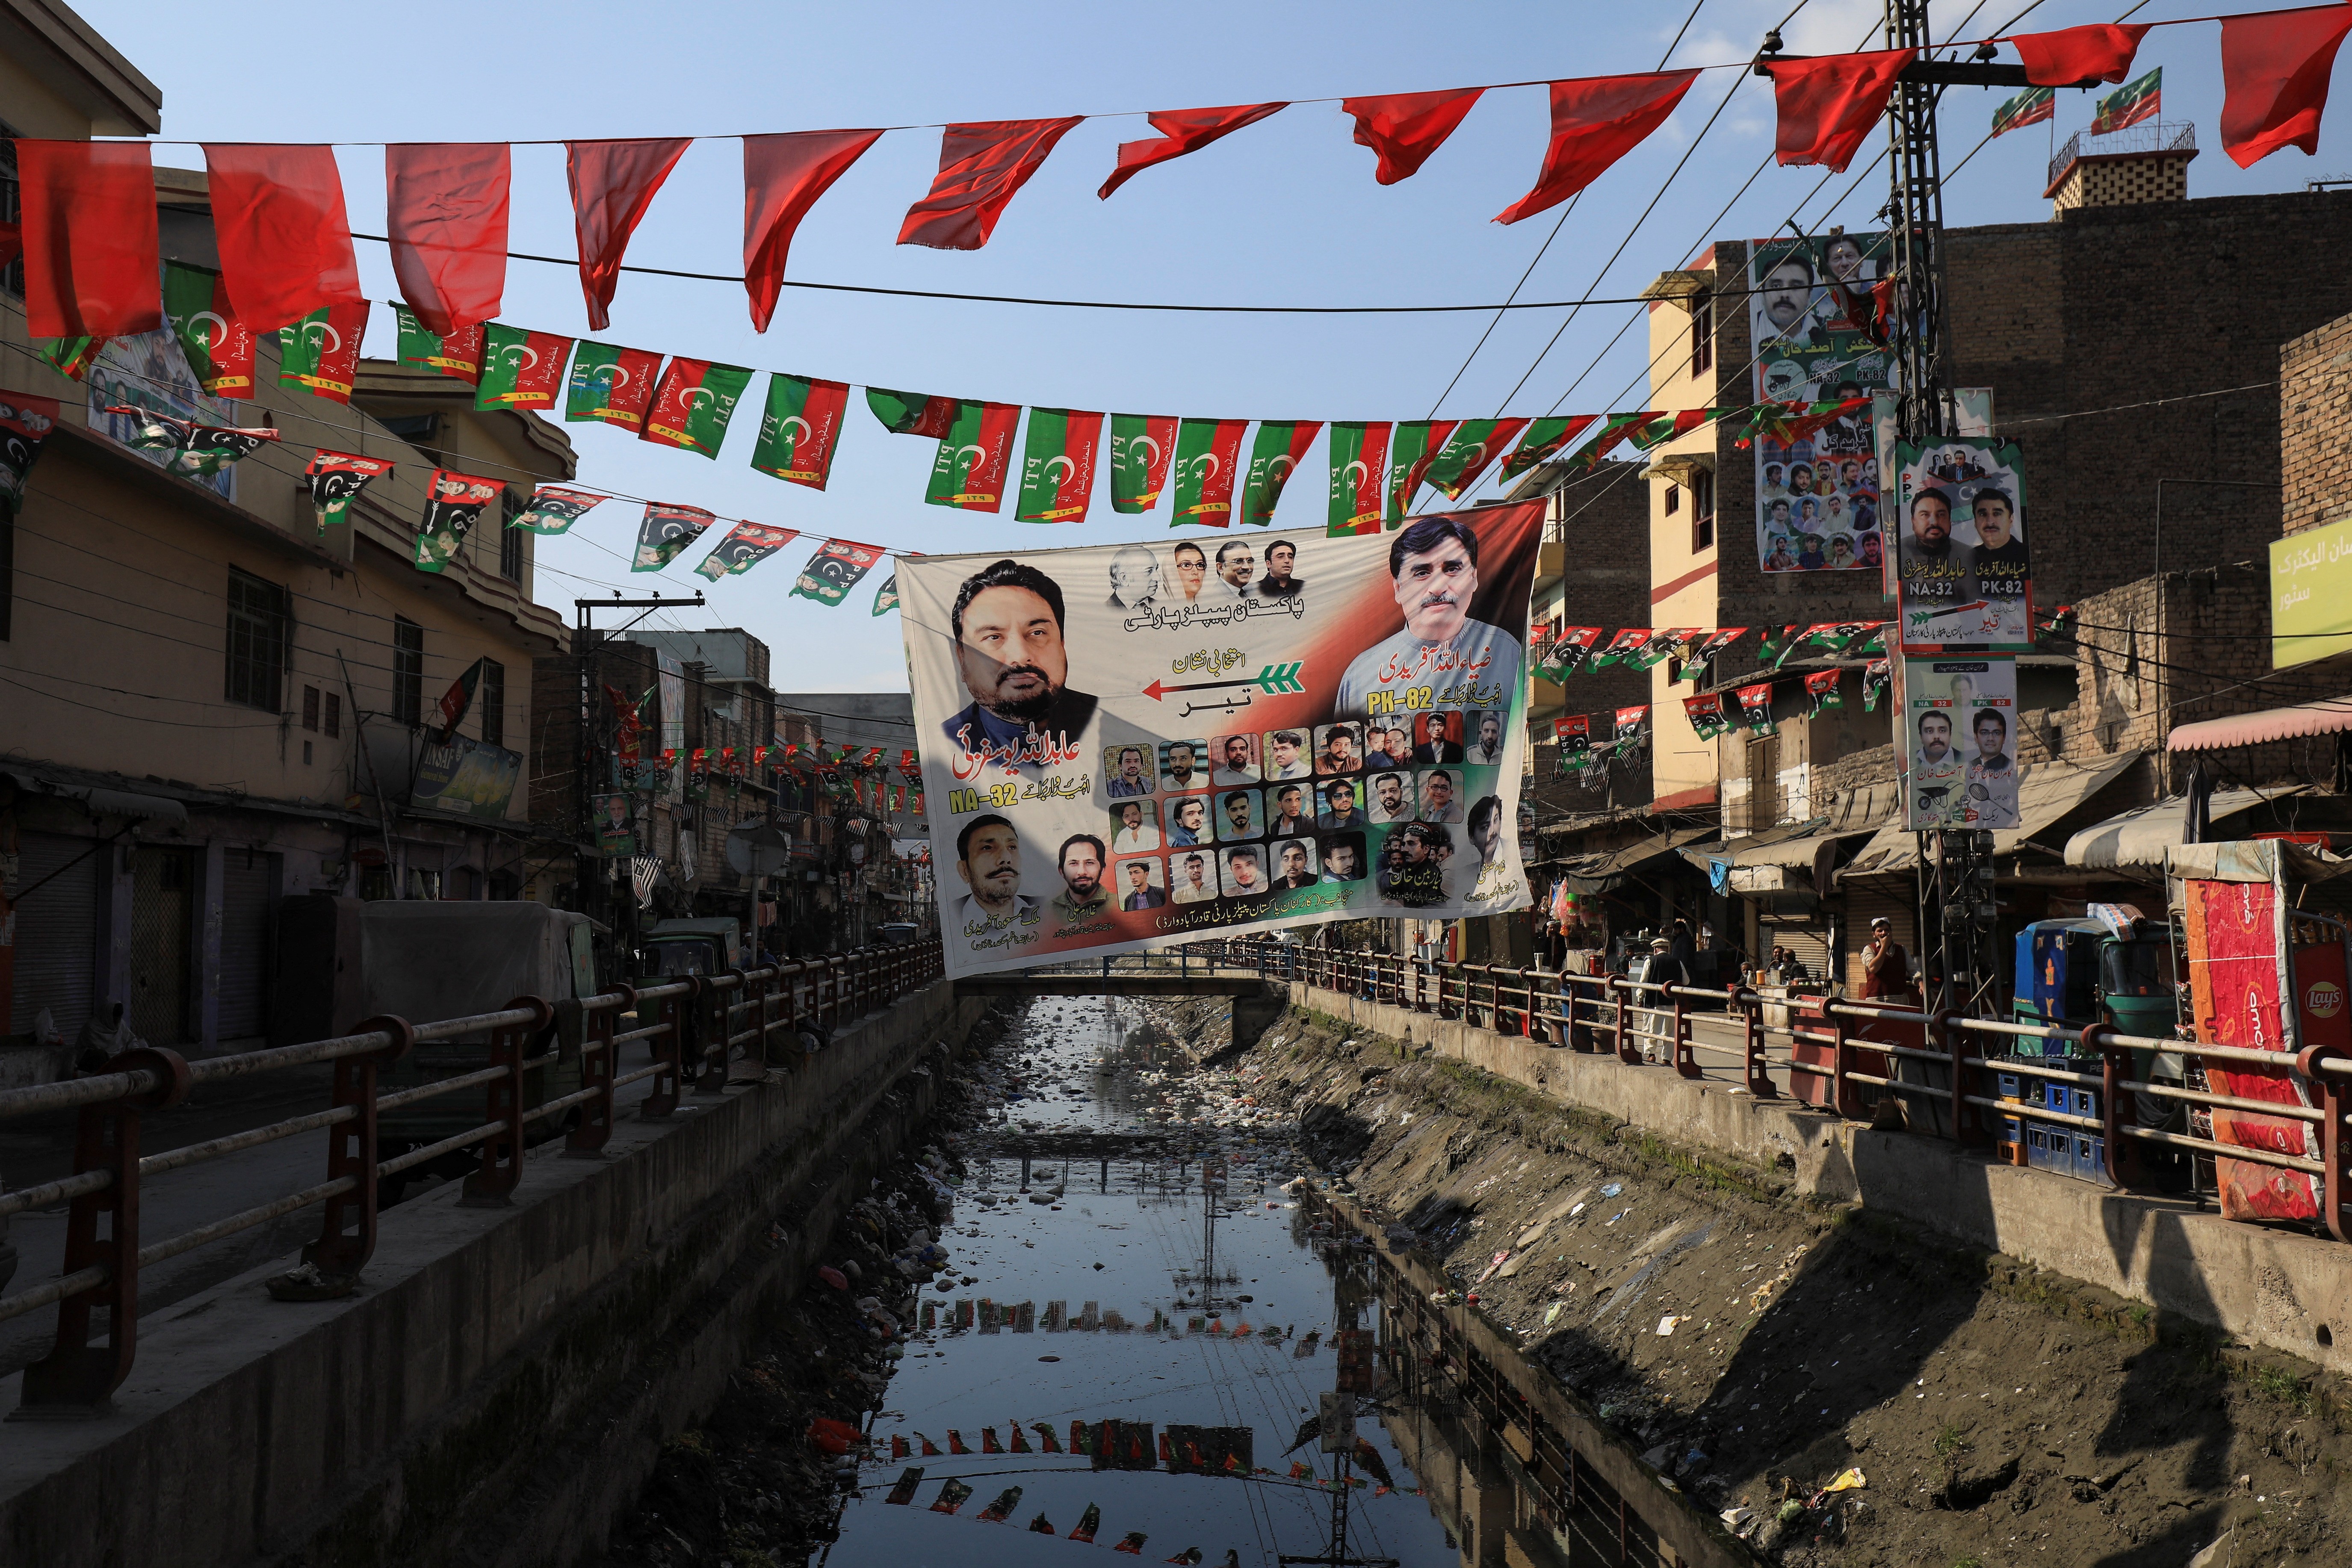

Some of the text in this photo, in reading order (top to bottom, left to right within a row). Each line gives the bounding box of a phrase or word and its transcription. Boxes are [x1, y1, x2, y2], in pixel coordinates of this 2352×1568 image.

[1808, 371, 1841, 384] NA-32
[1856, 369, 1886, 380] PK-82
[712, 393, 736, 428] PTI
[659, 427, 679, 439] PTI
[1821, 434, 1868, 452] فرید گل
[1975, 559, 1999, 577] آفریدی
[1909, 582, 1953, 596] NA-32
[1981, 580, 2023, 594] PK-82
[1123, 594, 1304, 632] پاکستان پیپلز پارٹی
[1924, 624, 1938, 640] پارٹی
[1946, 625, 1963, 639] پاکستان
[1978, 613, 2001, 634] تیر
[1172, 647, 1247, 677] انتخابی نشان
[1378, 644, 1441, 684] آفریدی
[1178, 688, 1253, 718] تیر
[1367, 685, 1433, 715] PK-82
[424, 742, 455, 770] INSAF
[1917, 765, 1963, 780] آصف خان
[1981, 768, 1994, 780] خان
[1993, 768, 2012, 780] کامران
[948, 783, 1018, 815] NA-32
[1390, 868, 1413, 886] خان
[1494, 859, 1505, 884] غلام
[1067, 900, 1096, 925] غلام علی
[1212, 902, 1232, 924] پارٹی
[1232, 901, 1250, 919] پیپلز
[1249, 897, 1280, 918] پاکستان
[963, 906, 1041, 937] ملک مسعود آفریدی
[2309, 990, 2340, 1010] Lay's
